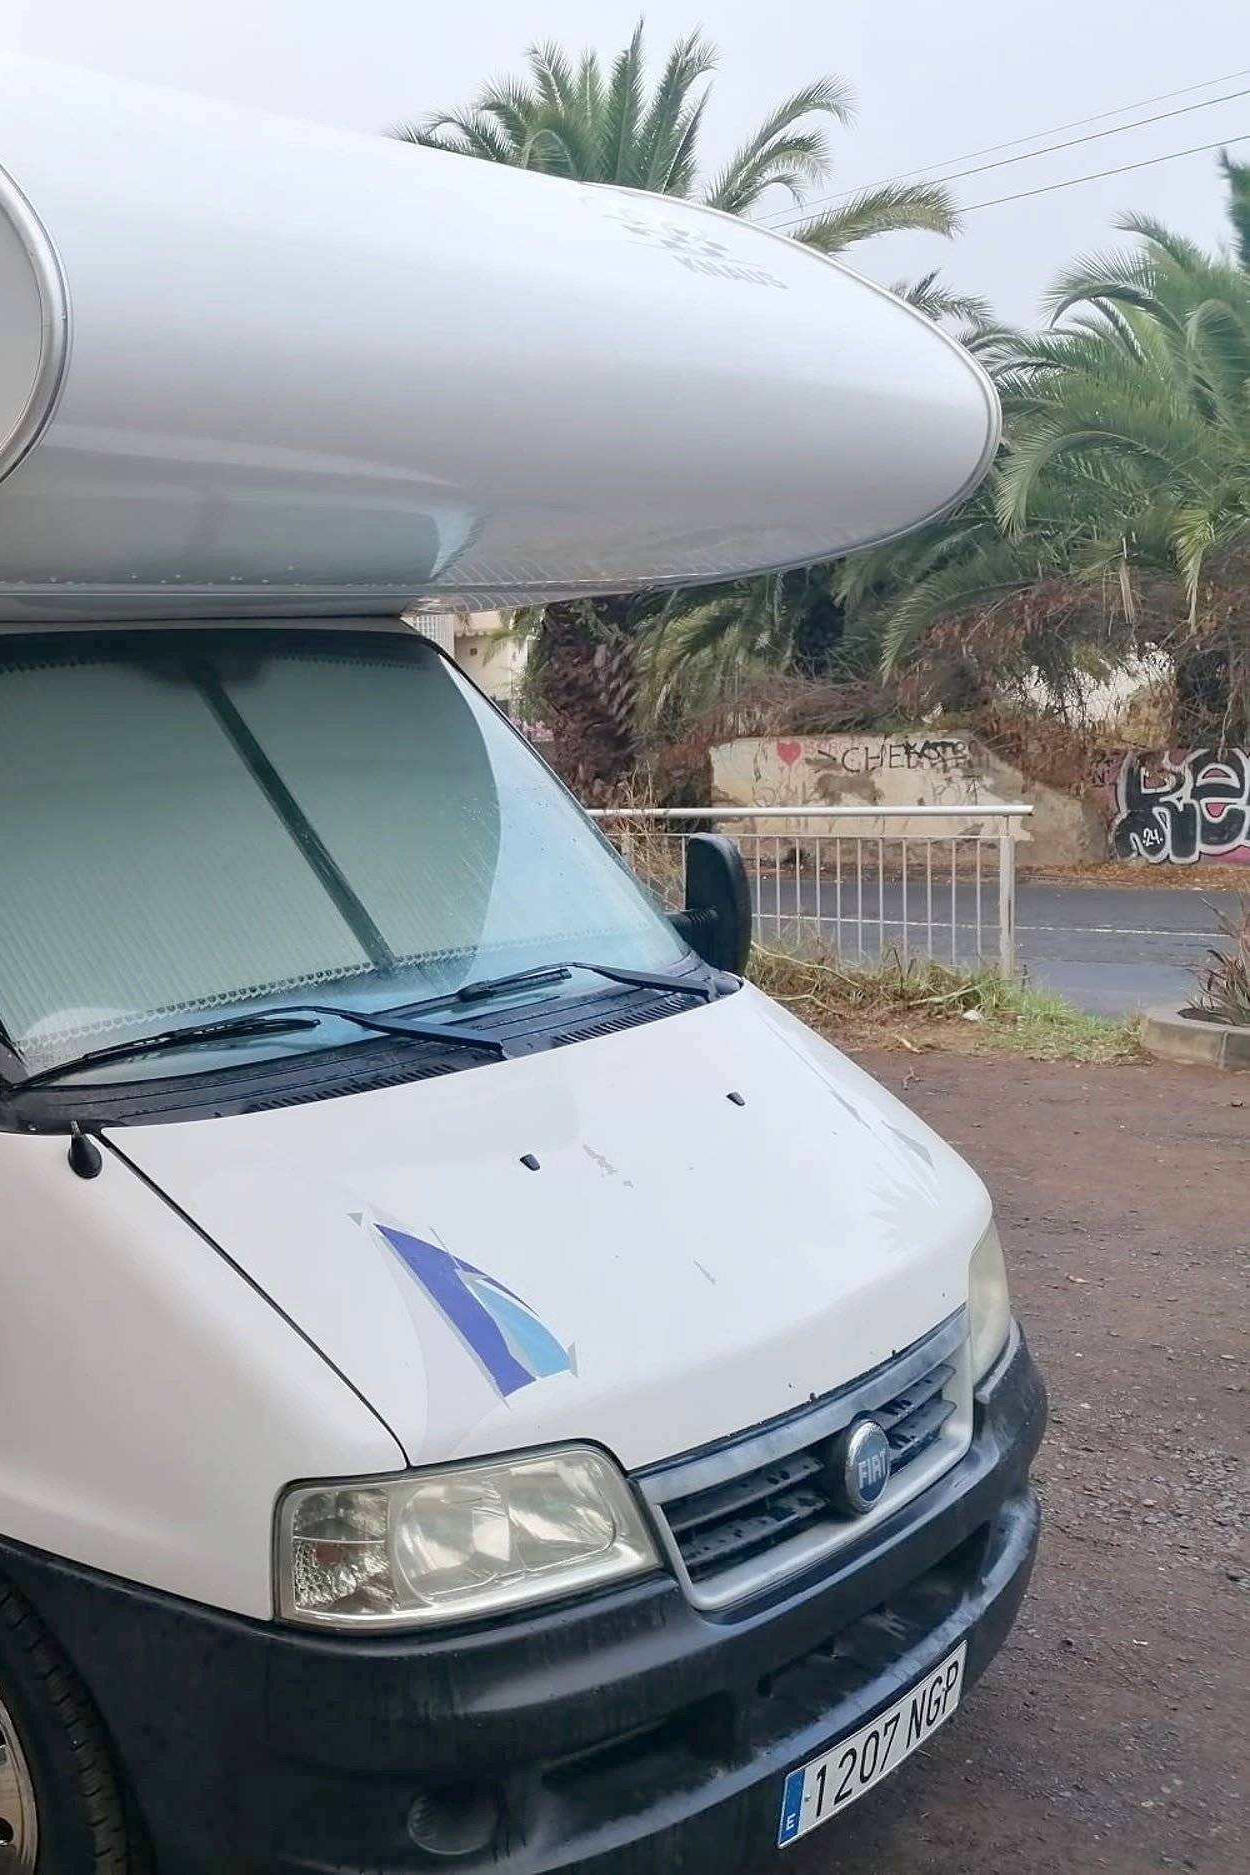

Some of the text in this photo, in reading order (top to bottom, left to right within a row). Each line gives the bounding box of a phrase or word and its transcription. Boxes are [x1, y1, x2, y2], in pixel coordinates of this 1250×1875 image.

[858, 1449, 887, 1489] FIAT
[816, 1662, 959, 1818] 1207 NGP
[786, 1812, 796, 1831] E
